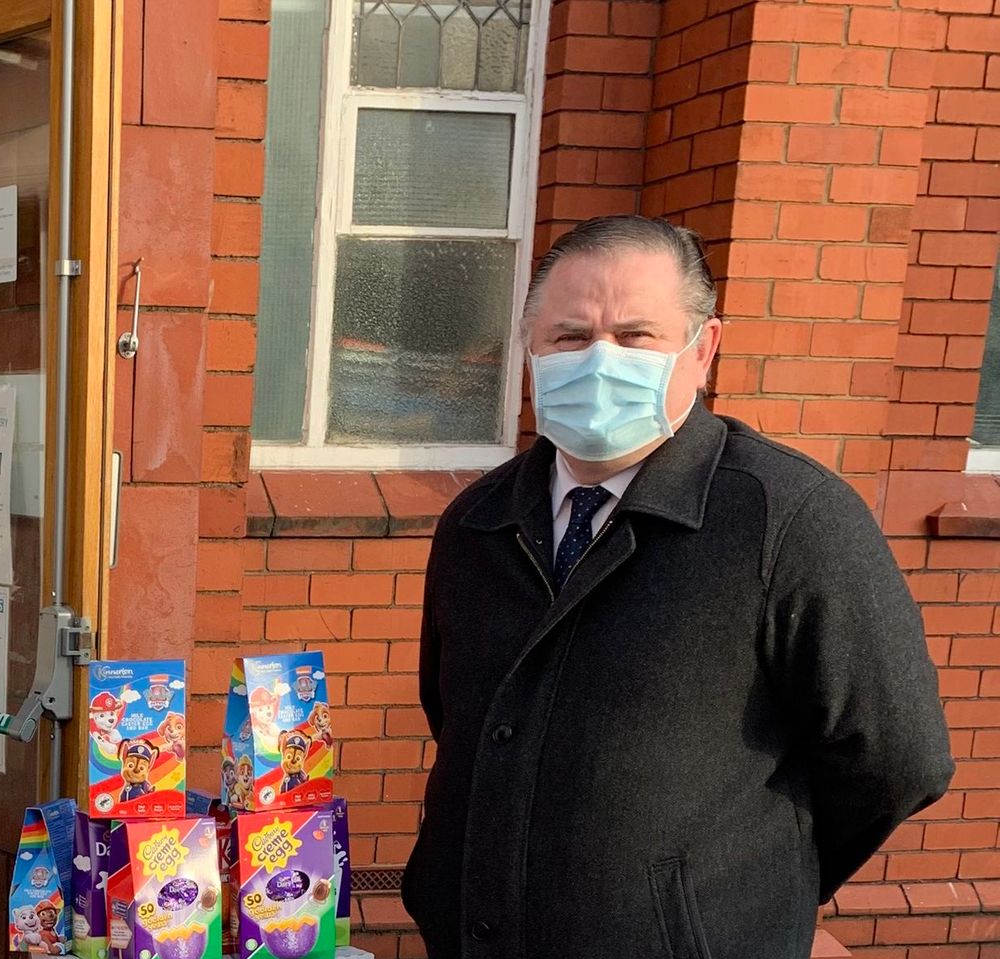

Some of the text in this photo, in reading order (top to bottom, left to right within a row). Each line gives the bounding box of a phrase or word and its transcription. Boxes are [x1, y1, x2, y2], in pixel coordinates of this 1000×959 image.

[148, 836, 177, 871] creme
[257, 829, 288, 862] creme
[269, 840, 293, 863] egg
[160, 848, 181, 872] egg
[140, 903, 154, 916] 50
[246, 893, 261, 906] 50
